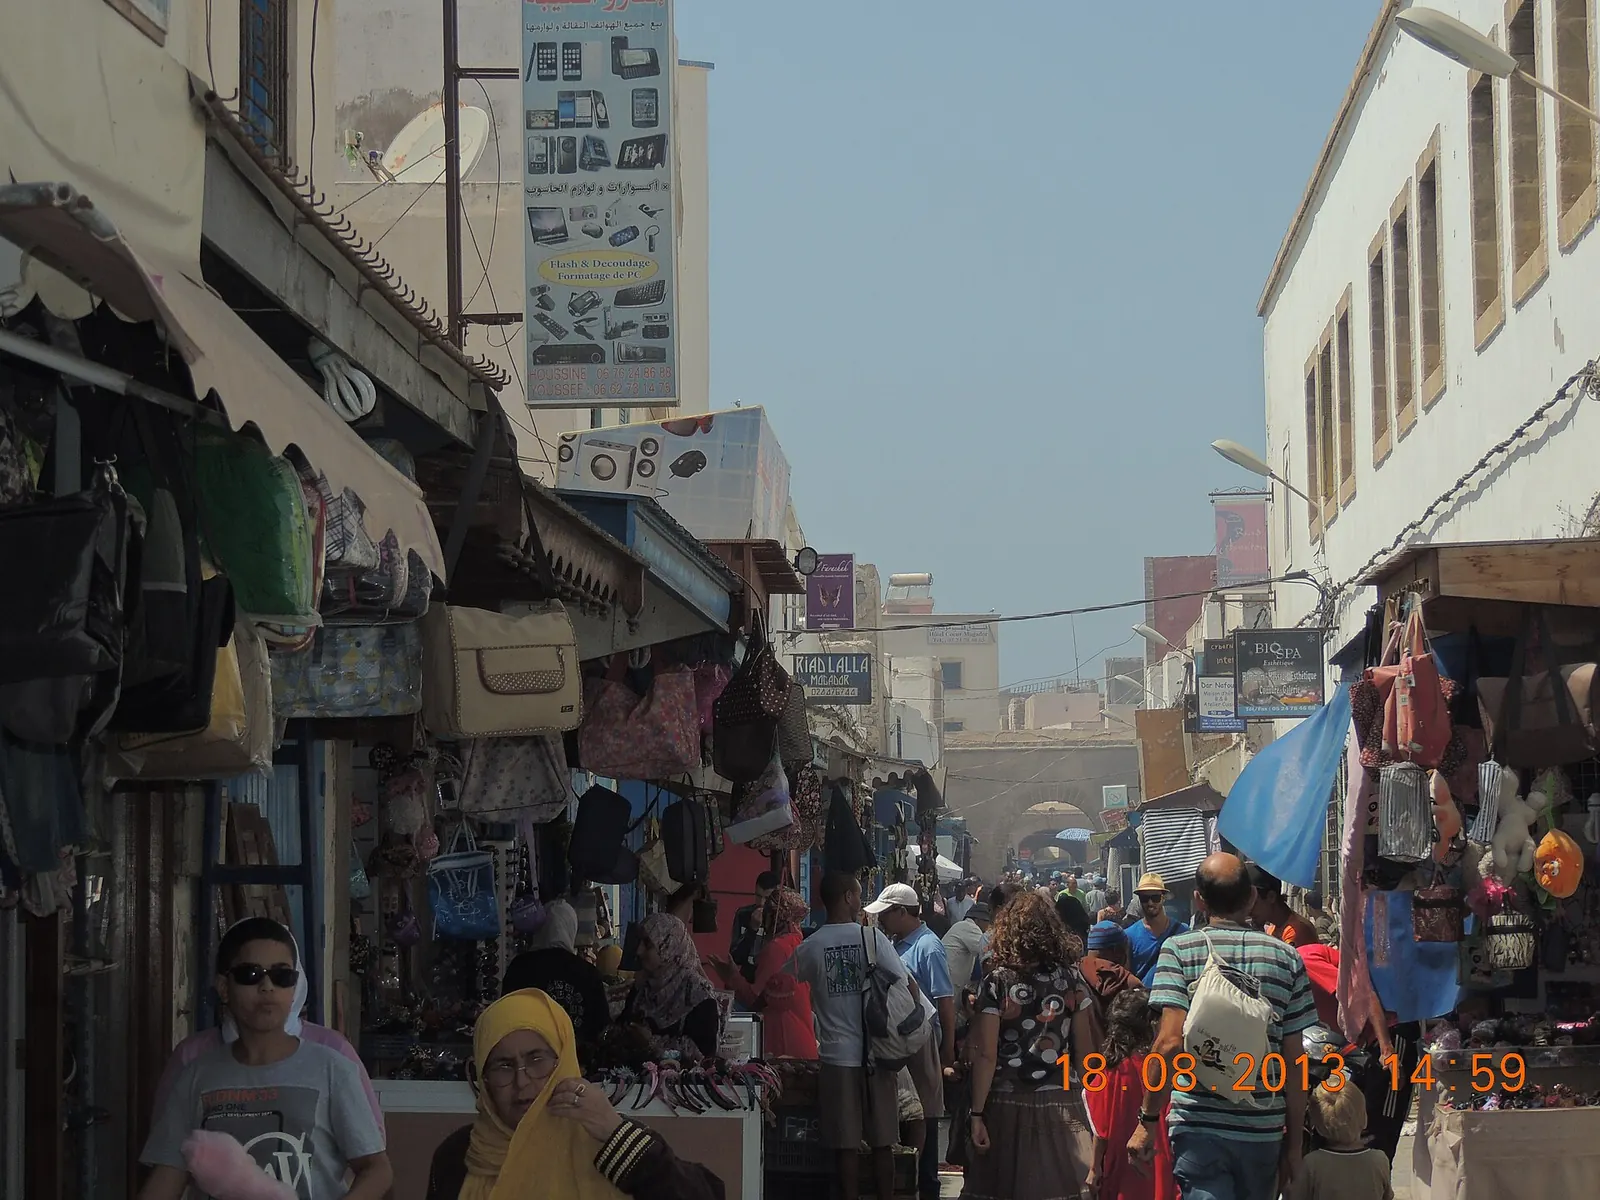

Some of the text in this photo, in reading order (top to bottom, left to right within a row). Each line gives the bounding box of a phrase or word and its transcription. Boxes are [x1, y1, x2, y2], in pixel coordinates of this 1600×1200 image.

[623, 20, 645, 31] جميع
[526, 184, 568, 197] الحاسوب
[570, 183, 596, 197] لوازم
[550, 260, 578, 269] Flash
[580, 260, 590, 268] &
[558, 271, 642, 281] Formatage de PC
[529, 367, 587, 380] HOUSSINE
[596, 367, 609, 379] 06
[530, 383, 583, 396] YOUSSEF
[828, 656, 868, 673] LALLA
[1263, 659, 1294, 667] Esthétique
[810, 674, 850, 686] MOGADOR
